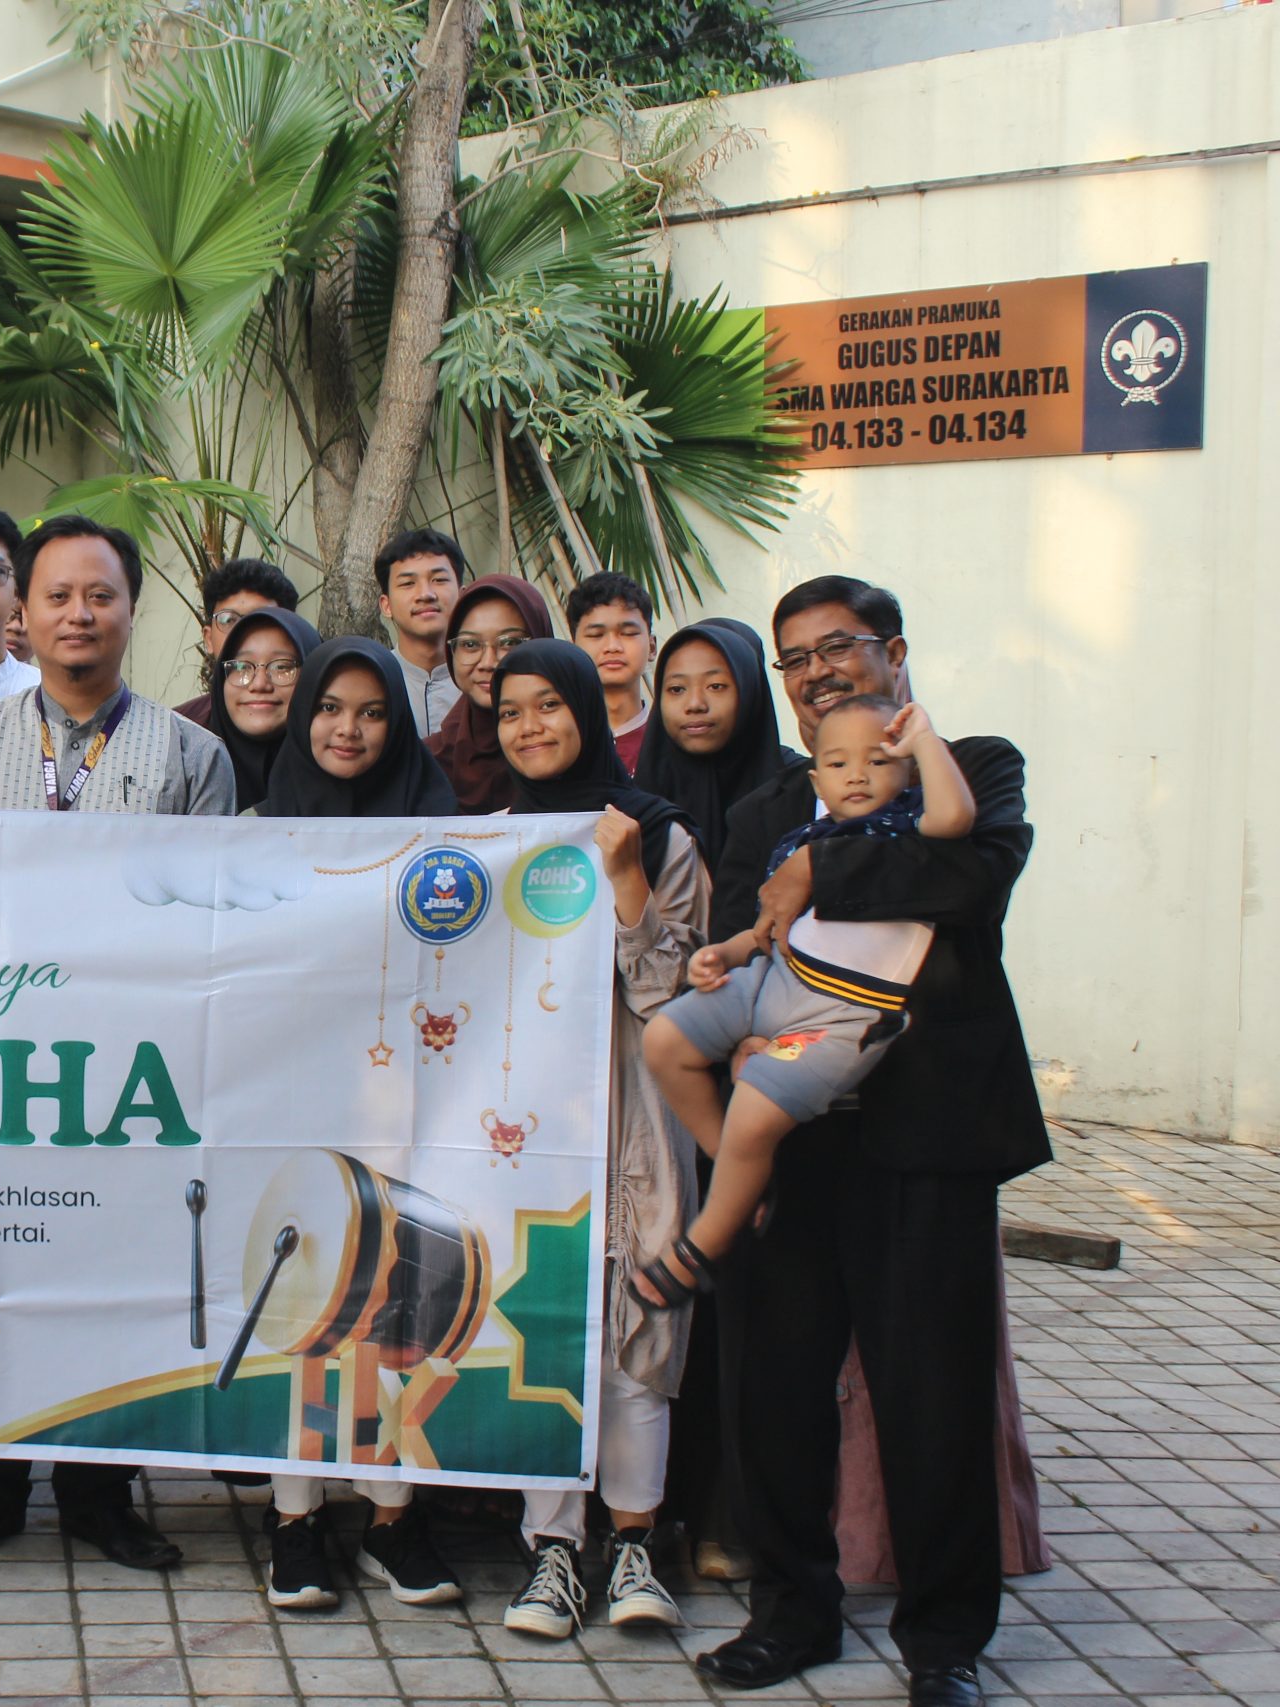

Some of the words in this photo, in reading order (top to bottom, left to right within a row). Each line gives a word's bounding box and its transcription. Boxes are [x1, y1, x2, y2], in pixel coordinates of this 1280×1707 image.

[839, 309, 913, 333] GERAKAN
[917, 300, 1001, 327] PRAMUKA
[838, 336, 918, 370] GUGUS
[923, 330, 1001, 364] DEPAN
[830, 376, 917, 410] WARGA
[923, 366, 1070, 405] SURAKARTA
[811, 416, 904, 452] 04.133
[929, 408, 1027, 445] 04.134
[43, 761, 57, 796] WARGA
[65, 768, 90, 803] WARGA
[528, 863, 587, 894] ROHIS
